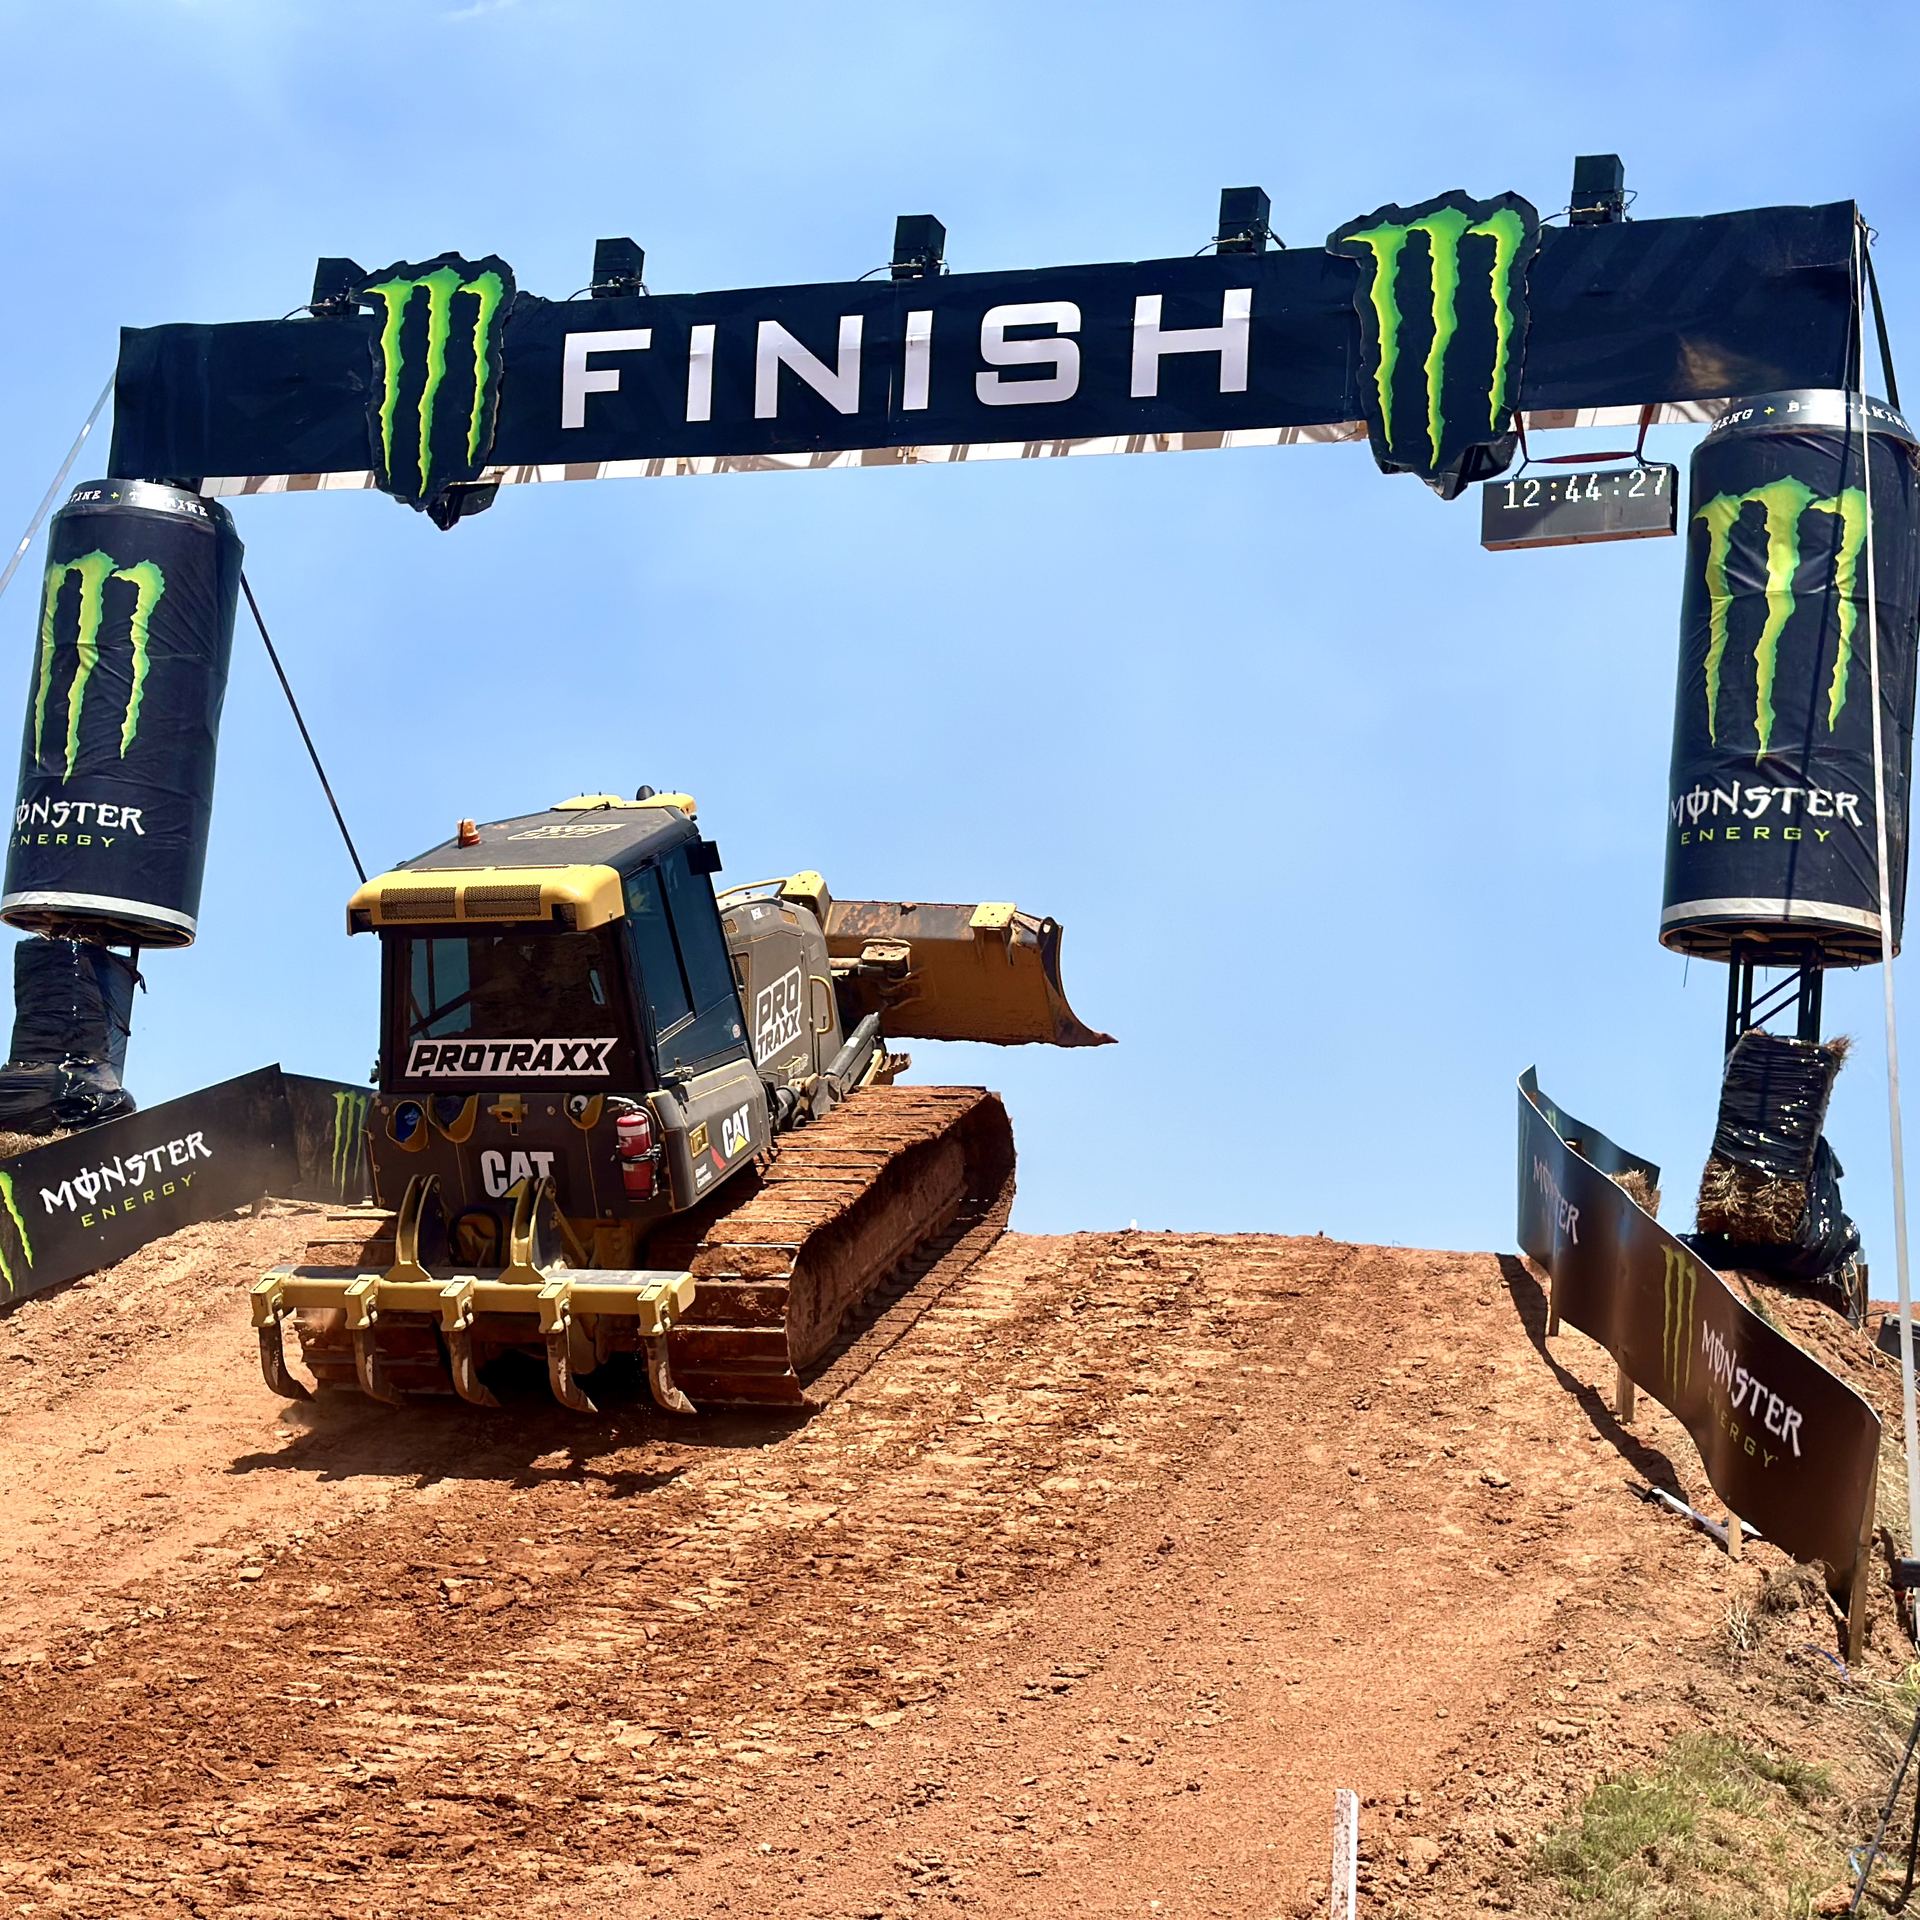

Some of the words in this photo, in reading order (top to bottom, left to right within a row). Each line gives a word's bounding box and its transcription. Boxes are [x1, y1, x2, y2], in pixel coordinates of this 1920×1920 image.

[561, 287, 1253, 429] FINISH
[1503, 466, 1668, 510] 12:44:27
[16, 795, 146, 836] ONSTER
[1670, 779, 1864, 828] MONSTER
[1680, 827, 1831, 845] ENERGY
[757, 968, 801, 1036] PRO
[407, 1040, 615, 1075] PROTRAXX
[756, 1009, 801, 1065] TRAXX
[722, 1103, 751, 1158] CAT
[39, 1130, 213, 1214] MONSTER
[480, 1150, 555, 1198] CAT
[81, 1174, 193, 1228] ENERGY
[1701, 1319, 1803, 1458] MONSTER
